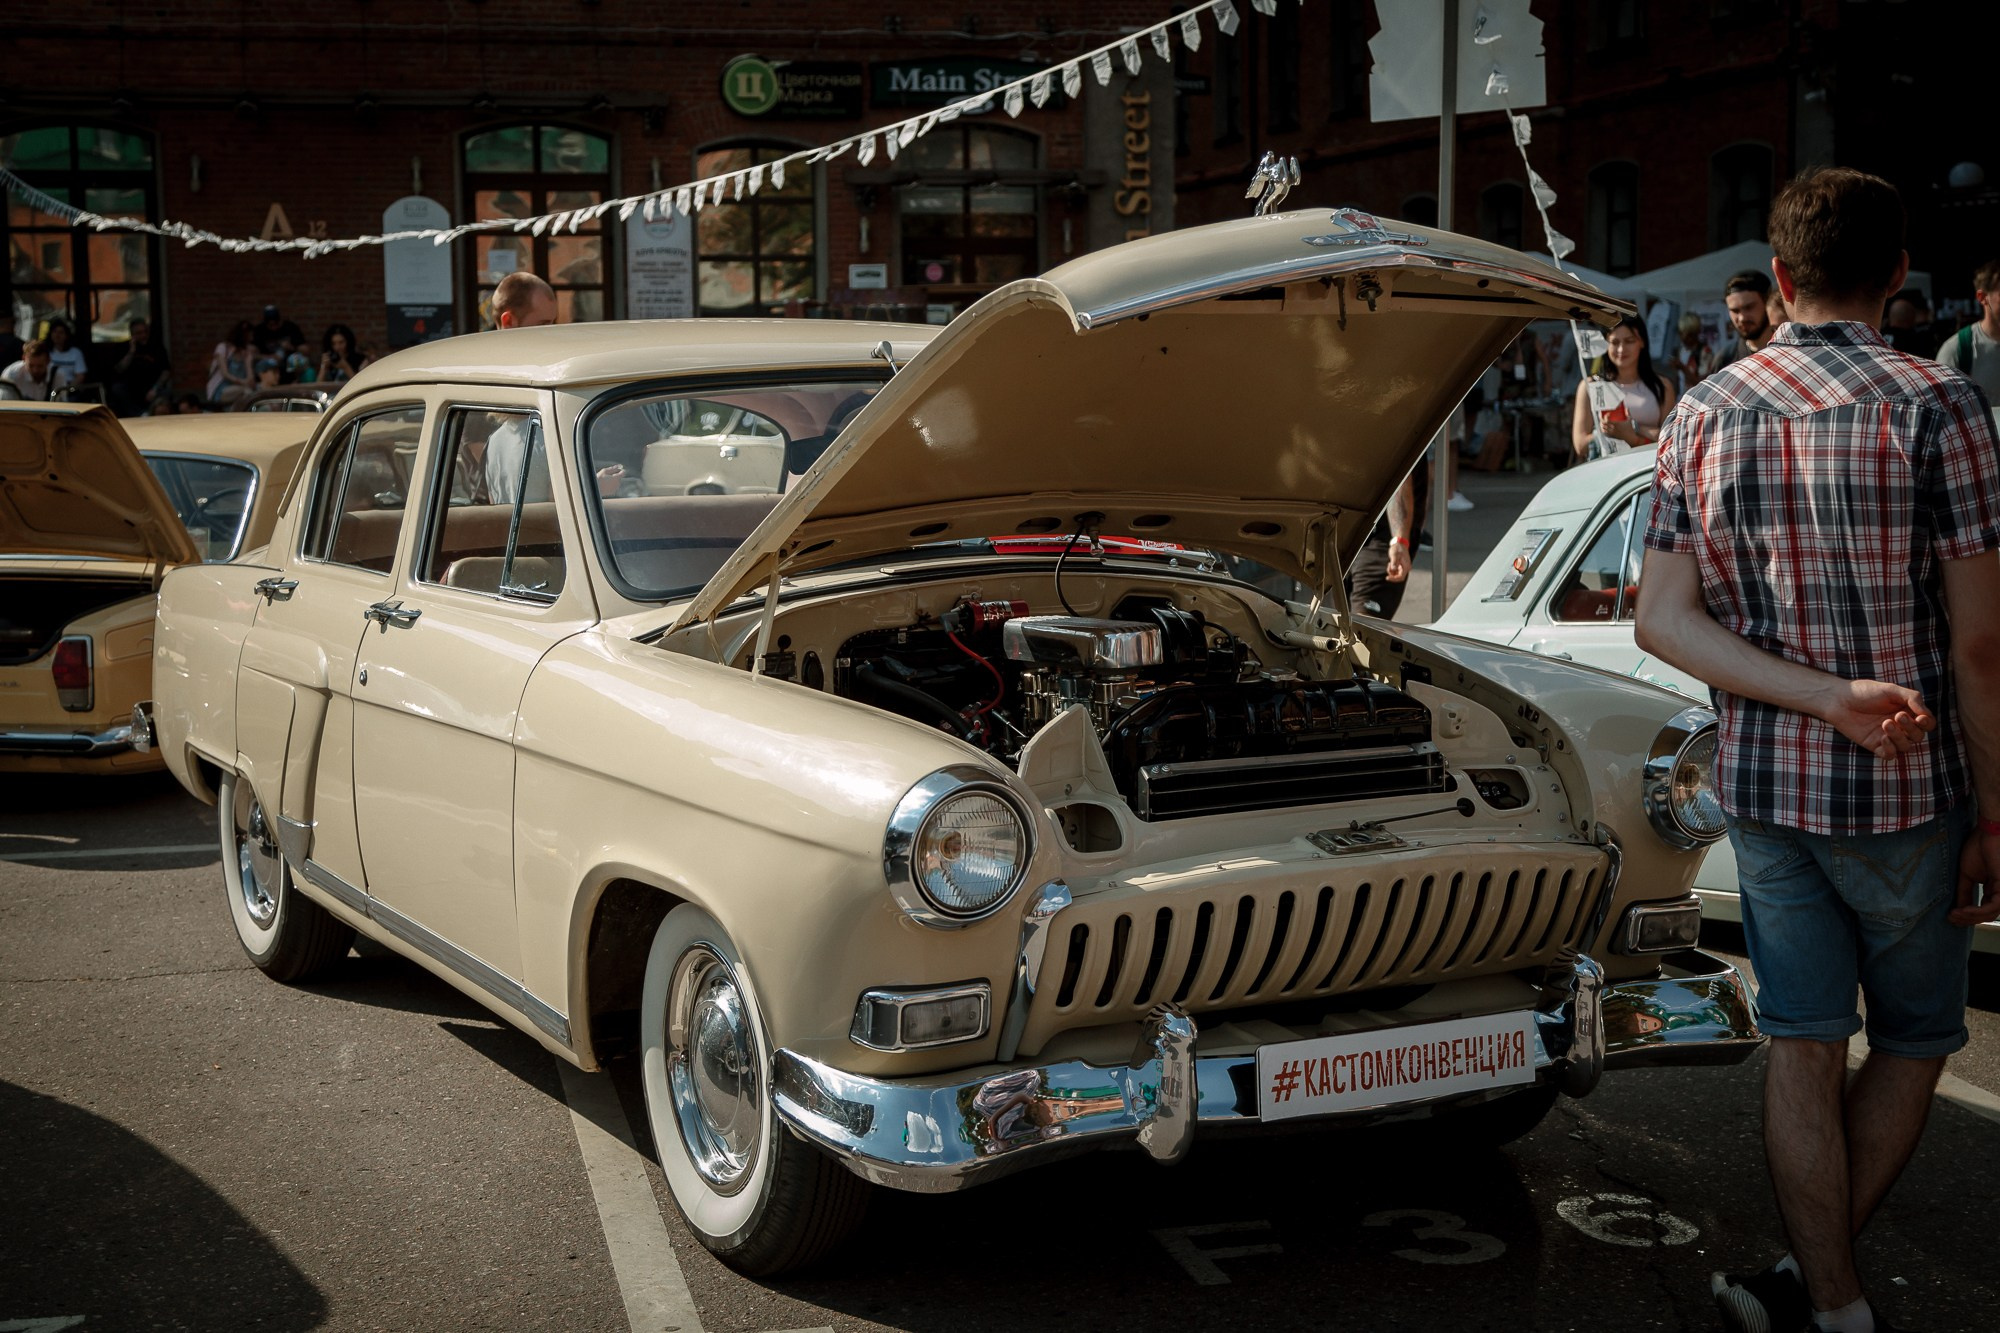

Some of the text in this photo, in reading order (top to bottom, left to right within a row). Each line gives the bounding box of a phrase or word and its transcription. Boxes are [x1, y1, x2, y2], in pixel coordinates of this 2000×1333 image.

[735, 72, 766, 102] Ц
[777, 71, 862, 88] Цветочная
[888, 67, 967, 92] Main
[777, 88, 835, 107] Марка
[1114, 88, 1151, 216] Street
[1271, 1030, 1526, 1104] #КАСТОМКОНВЕНЦИЯ
